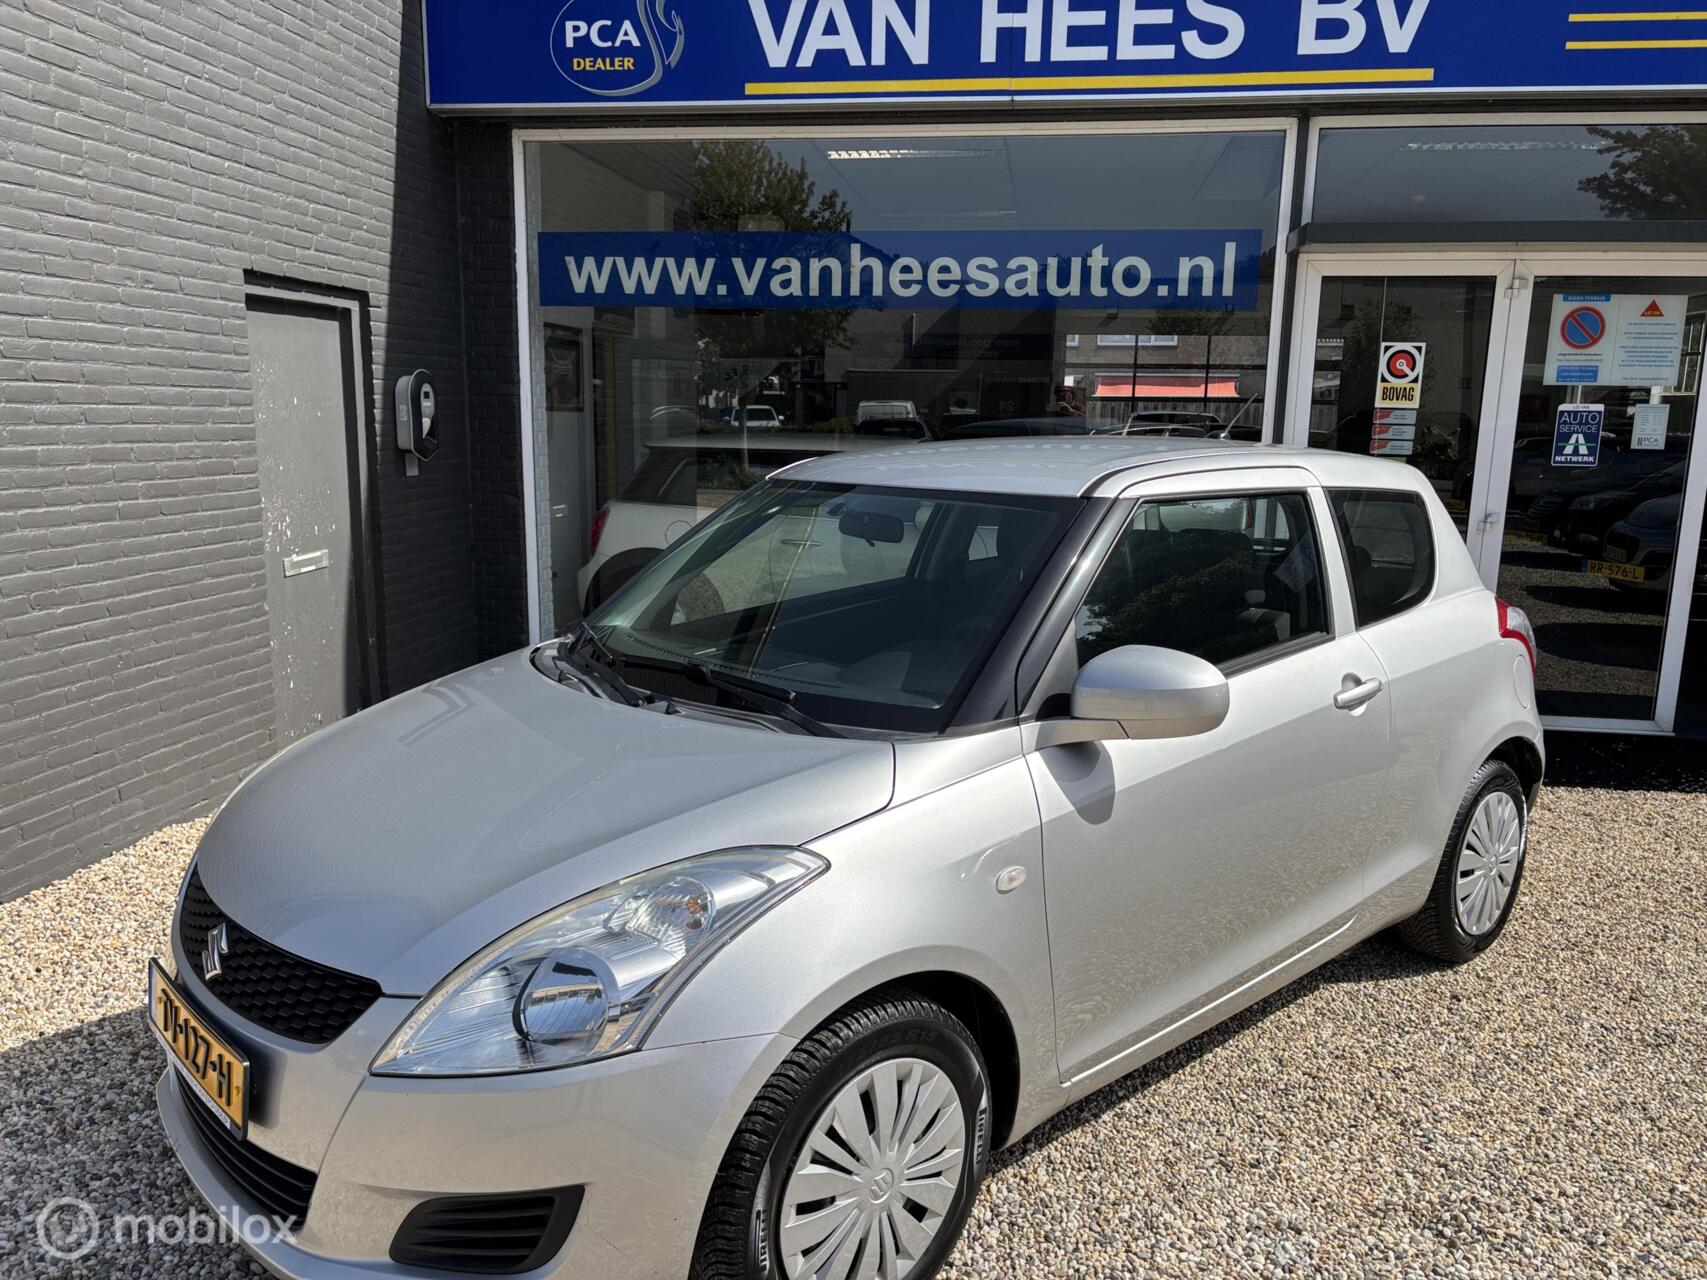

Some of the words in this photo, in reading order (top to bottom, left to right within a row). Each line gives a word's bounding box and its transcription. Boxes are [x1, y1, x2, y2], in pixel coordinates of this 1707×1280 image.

[565, 19, 641, 48] PCA
[748, 0, 930, 68] VAN
[980, 0, 1245, 62] HEES
[1297, 0, 1435, 55] BV
[573, 57, 635, 71] DEALER
[564, 242, 1237, 299] www.vanheesauto.nl
[1382, 387, 1415, 402] BOVAG
[1560, 412, 1600, 424] AUTO
[1559, 425, 1598, 433] SERVICE
[1590, 560, 1640, 580] RR-576-L
